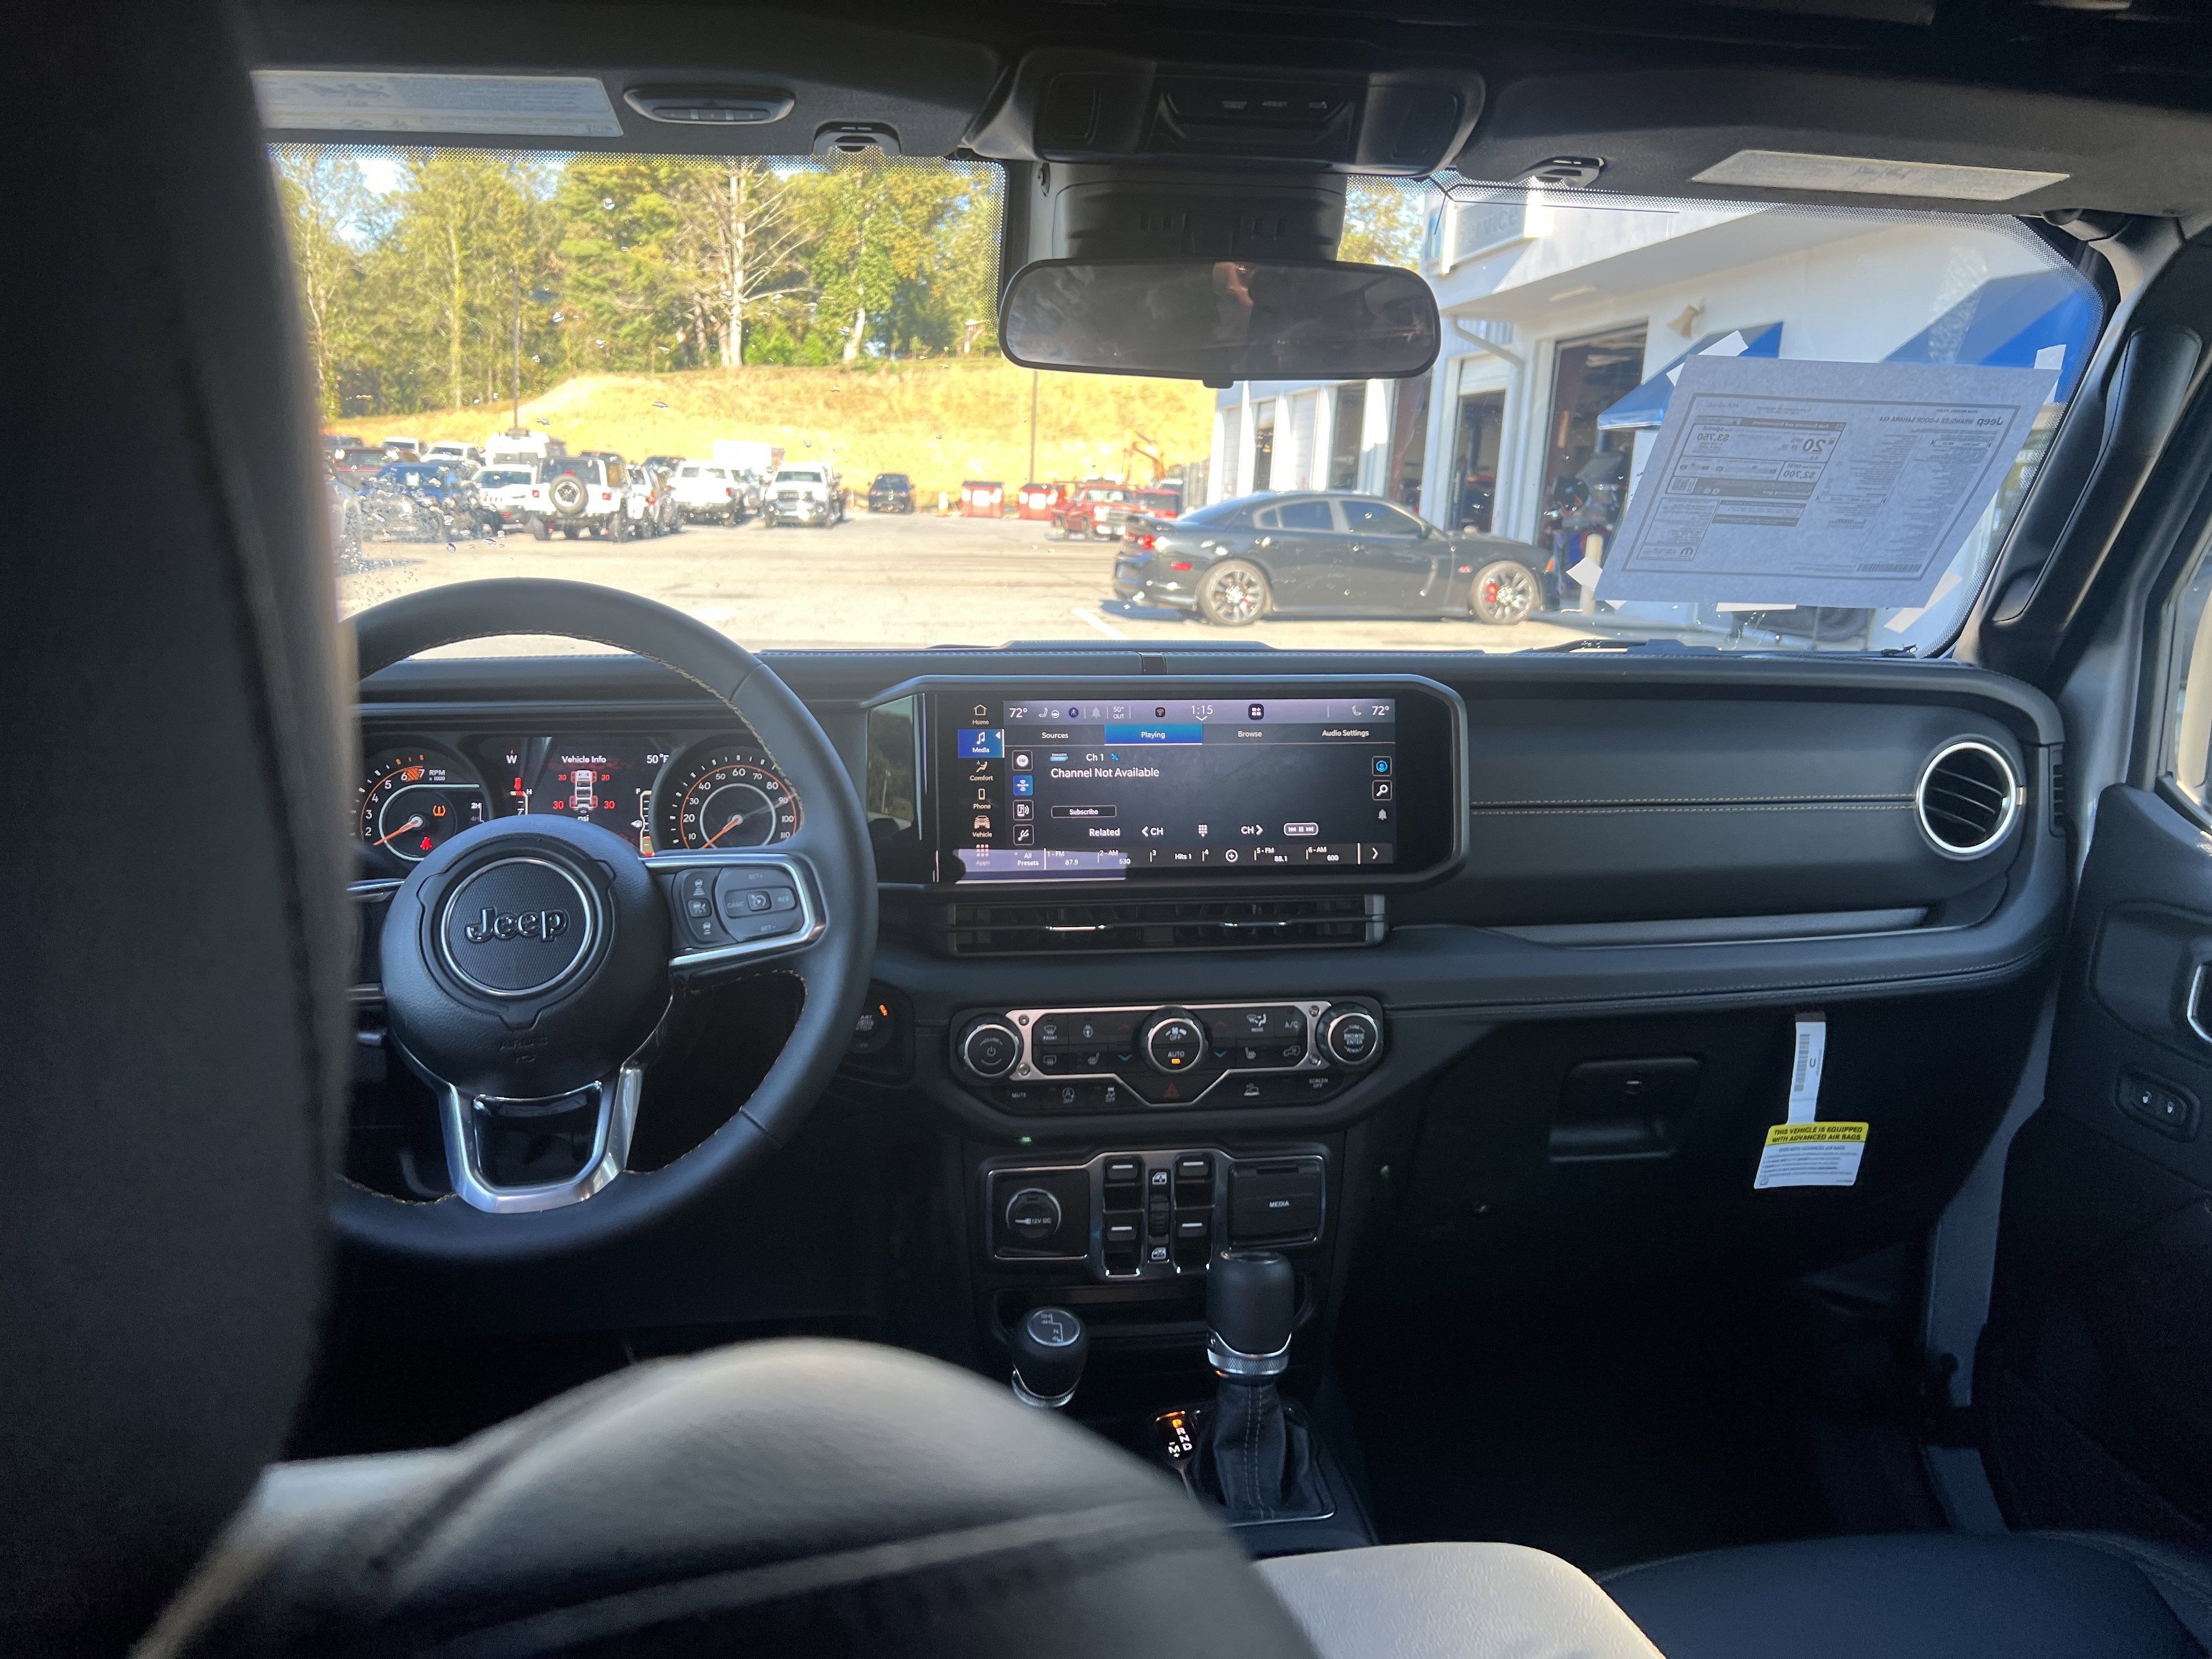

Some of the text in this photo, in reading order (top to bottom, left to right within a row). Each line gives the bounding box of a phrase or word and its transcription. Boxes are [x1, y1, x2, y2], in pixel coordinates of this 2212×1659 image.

[1009, 707, 1028, 718] 72°
[1191, 704, 1214, 715] 1:15
[1372, 705, 1389, 716] 72°
[1342, 730, 1369, 738] Settings
[506, 755, 517, 764] W
[400, 772, 408, 781] 6
[418, 769, 425, 778] 7
[732, 768, 746, 776] 60
[1051, 768, 1160, 778] Channel Not Available
[385, 780, 392, 789] 5
[698, 782, 711, 790] 40
[766, 782, 779, 790] 80
[371, 793, 379, 803] 4
[778, 797, 788, 805] 90
[553, 800, 565, 810] 30
[604, 800, 616, 809] 30
[365, 809, 373, 819] 3
[684, 814, 695, 822] 20
[365, 827, 372, 837] 2
[1089, 828, 1120, 837] Related
[1150, 827, 1164, 836] CH
[1240, 826, 1255, 834] CH
[465, 907, 570, 943] Jeep
[1789, 1133, 1826, 1142] ADVANCED
[1172, 1419, 1182, 1428] P
[1179, 1435, 1190, 1443] N
[1168, 1444, 1181, 1454] M
[1182, 1443, 1192, 1451] D
